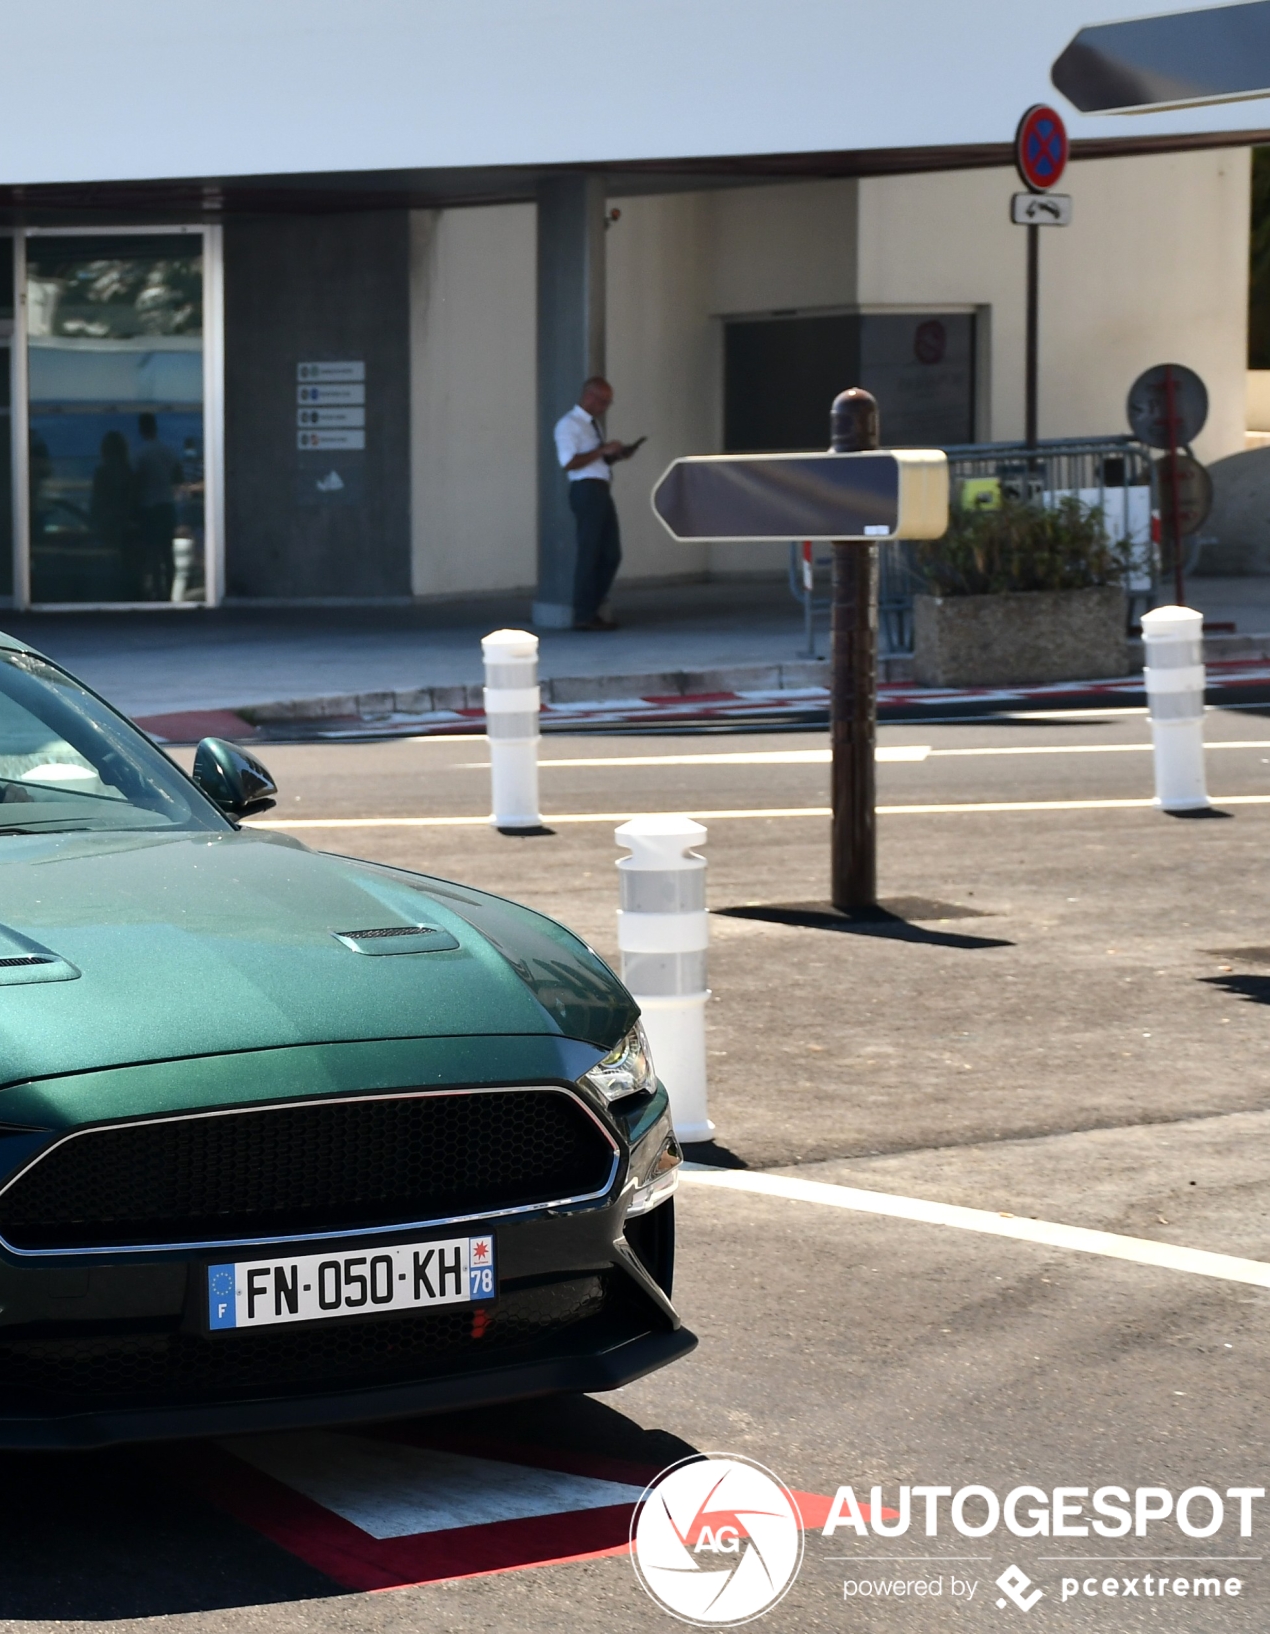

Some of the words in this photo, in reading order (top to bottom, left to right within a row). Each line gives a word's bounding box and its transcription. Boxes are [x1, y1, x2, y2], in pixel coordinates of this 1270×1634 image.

[246, 1246, 462, 1319] FN-050-KH
[470, 1268, 493, 1294] 78
[218, 1303, 228, 1318] F
